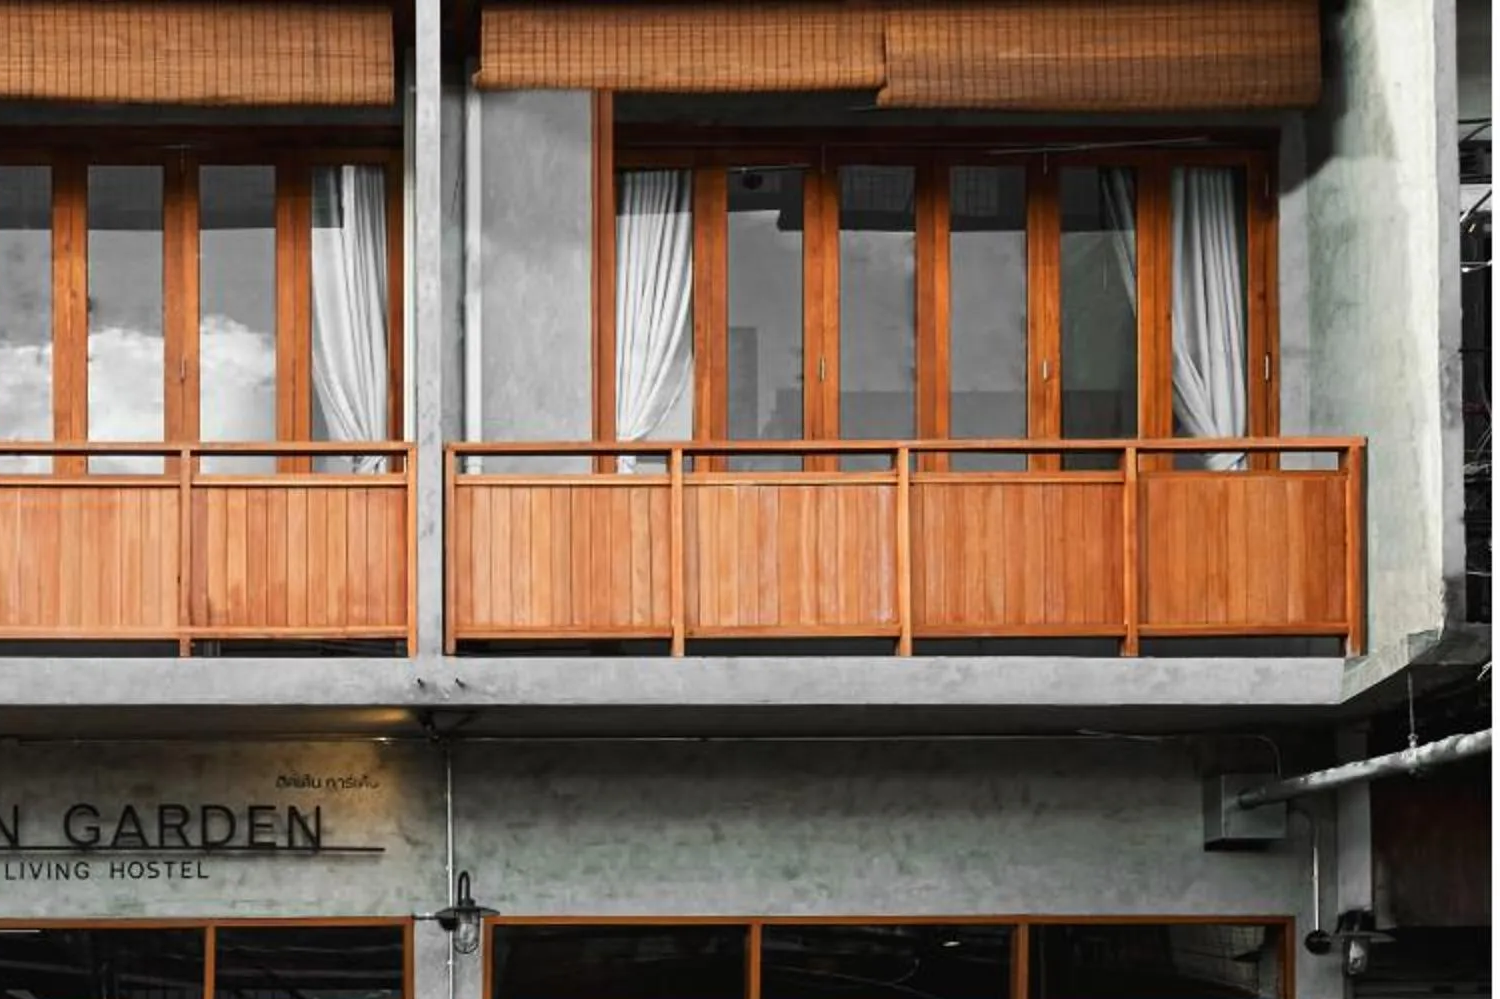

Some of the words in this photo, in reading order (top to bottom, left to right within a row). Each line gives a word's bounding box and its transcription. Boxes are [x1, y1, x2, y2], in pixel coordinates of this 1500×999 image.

[63, 803, 321, 849] GARDEN
[4, 861, 90, 880] LIVING
[110, 860, 209, 880] HOSTEL
